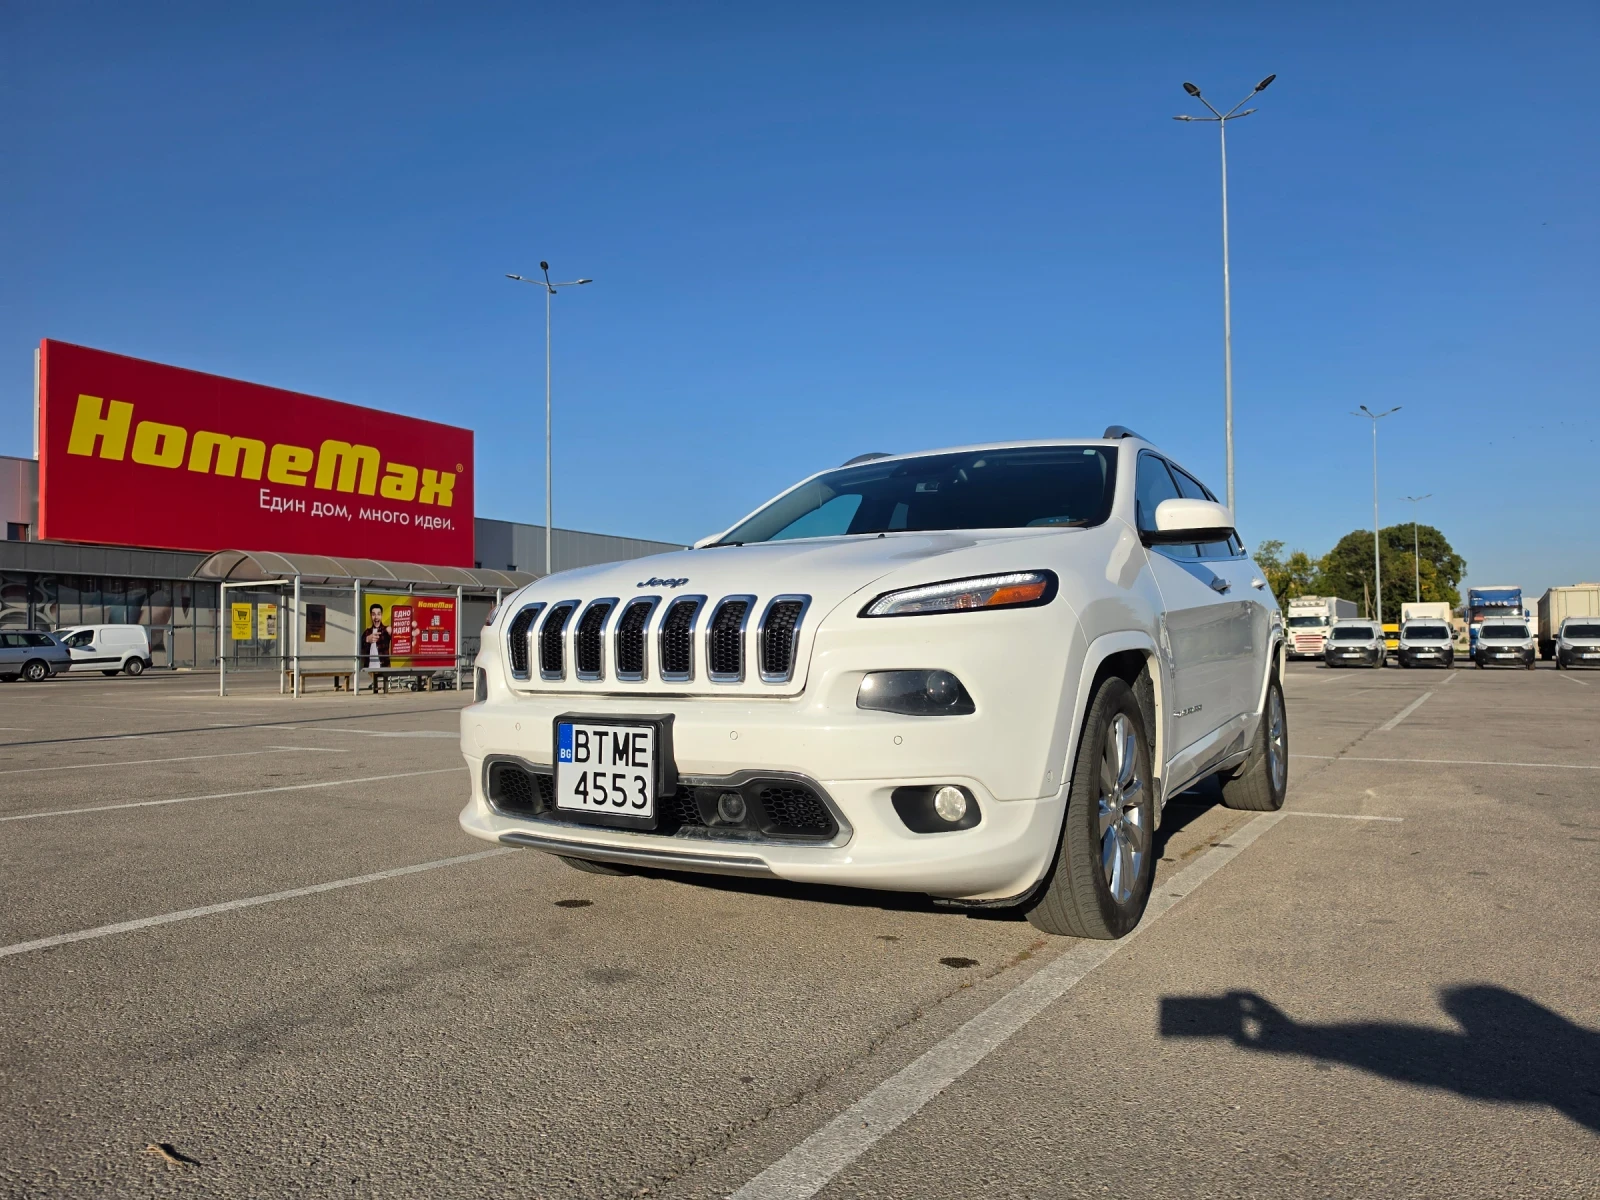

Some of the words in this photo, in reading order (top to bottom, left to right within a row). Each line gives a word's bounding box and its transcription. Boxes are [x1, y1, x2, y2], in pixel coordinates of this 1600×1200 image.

[67, 394, 457, 507] HomeMax
[259, 488, 306, 513] Един
[311, 501, 352, 521] дом,
[359, 507, 410, 525] много
[414, 514, 455, 531] идеи.
[636, 577, 689, 589] Jeep
[394, 610, 411, 618] ЕДНО
[560, 748, 572, 759] BG
[574, 729, 649, 768] BTME
[574, 771, 648, 809] 4553
